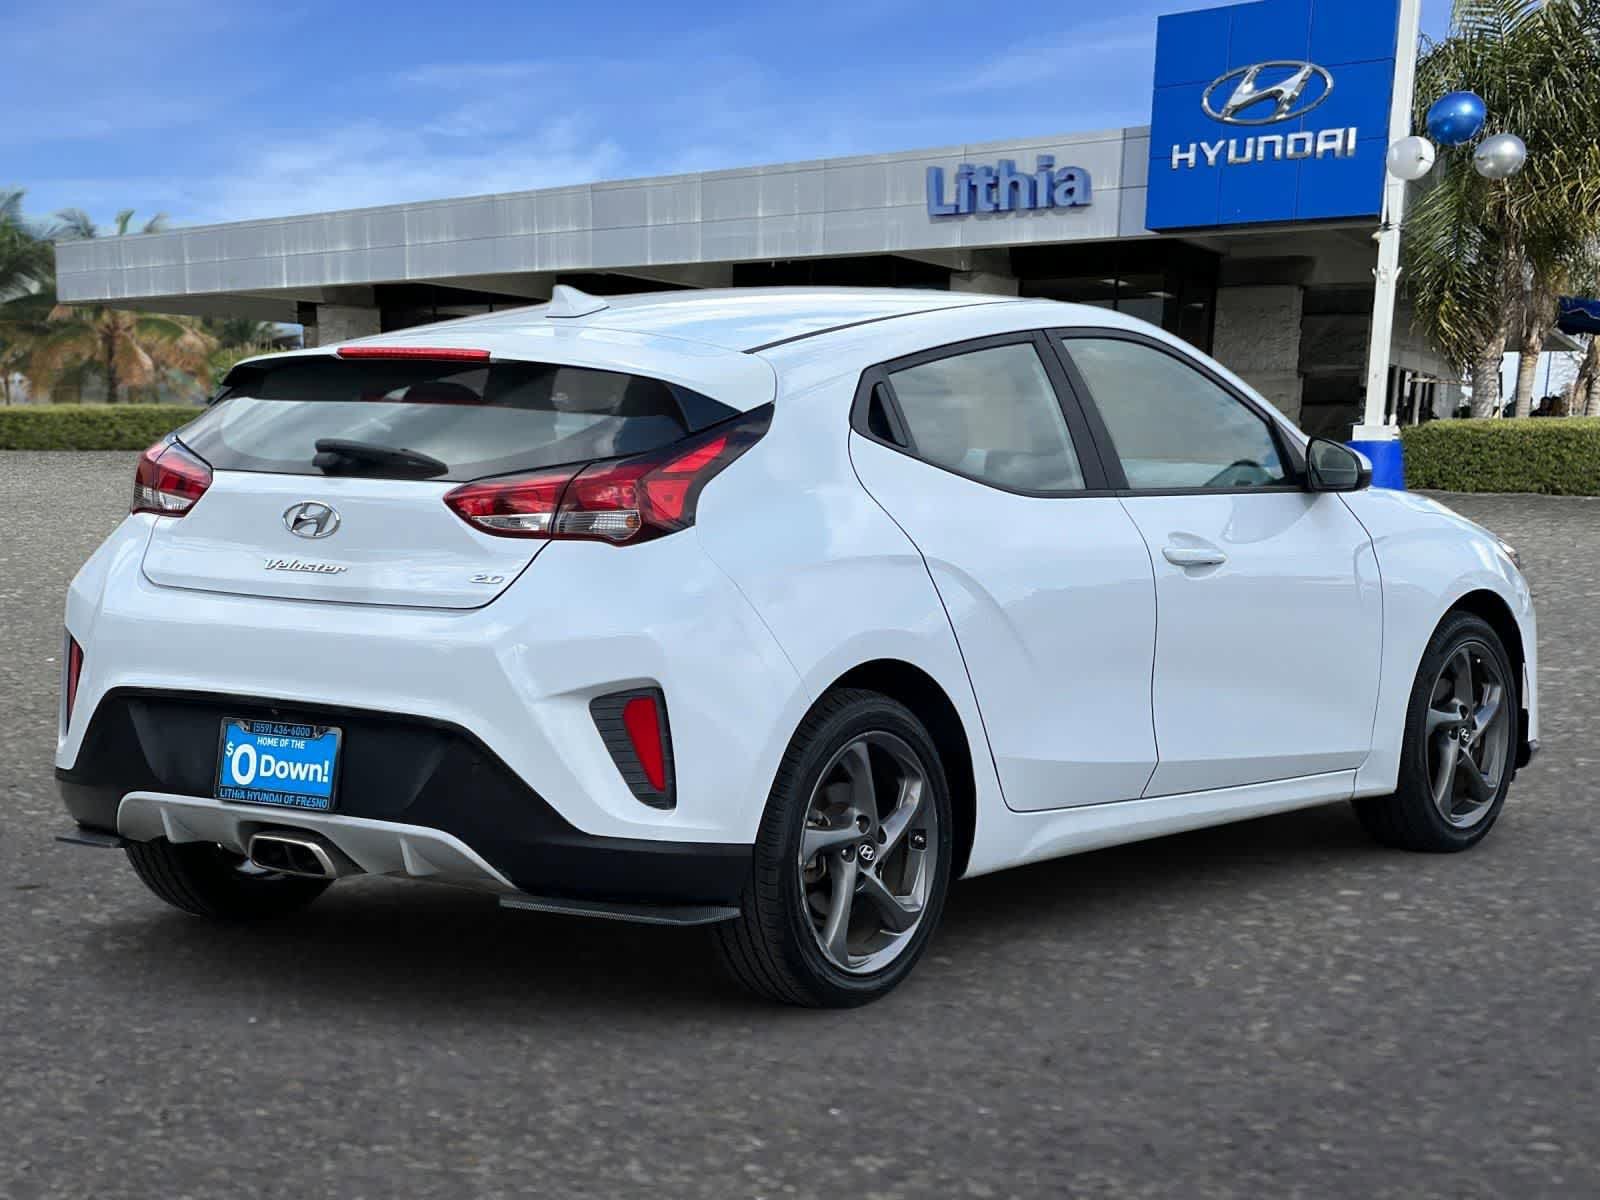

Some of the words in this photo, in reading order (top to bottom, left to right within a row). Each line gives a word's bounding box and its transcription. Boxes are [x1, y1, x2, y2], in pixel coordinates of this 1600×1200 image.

[1170, 127, 1358, 170] HYUNDAI
[925, 154, 1093, 217] Lithia
[264, 558, 348, 575] Veloster
[256, 736, 279, 747] HOME
[279, 738, 290, 747] OF
[291, 739, 305, 750] THE
[259, 754, 330, 783] Down!
[247, 790, 283, 804] HYUNDAI
[283, 794, 295, 805] OF
[295, 795, 328, 809] FRESNO
